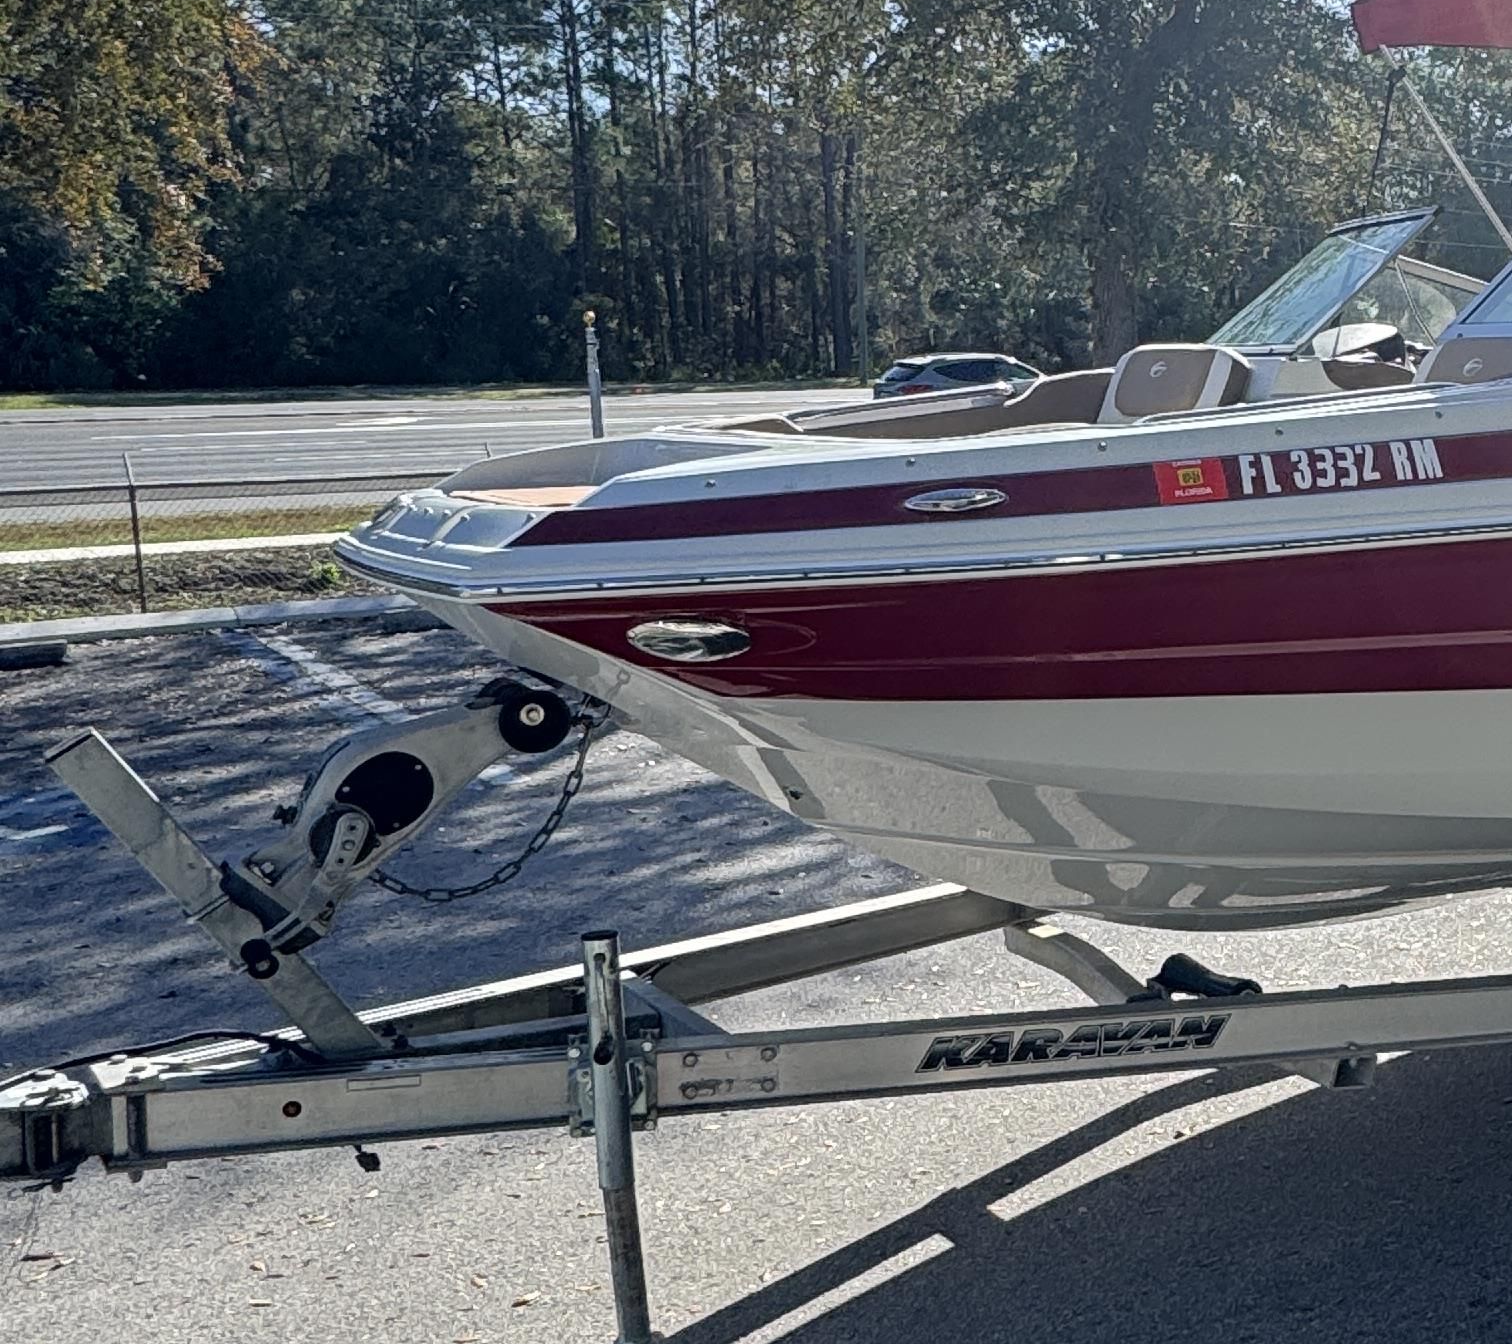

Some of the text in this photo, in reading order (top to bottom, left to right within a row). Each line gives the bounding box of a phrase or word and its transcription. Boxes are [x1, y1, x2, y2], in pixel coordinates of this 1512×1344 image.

[1238, 438, 1444, 495] FL 3332 RM
[915, 1013, 1232, 1073] KARAVAN
